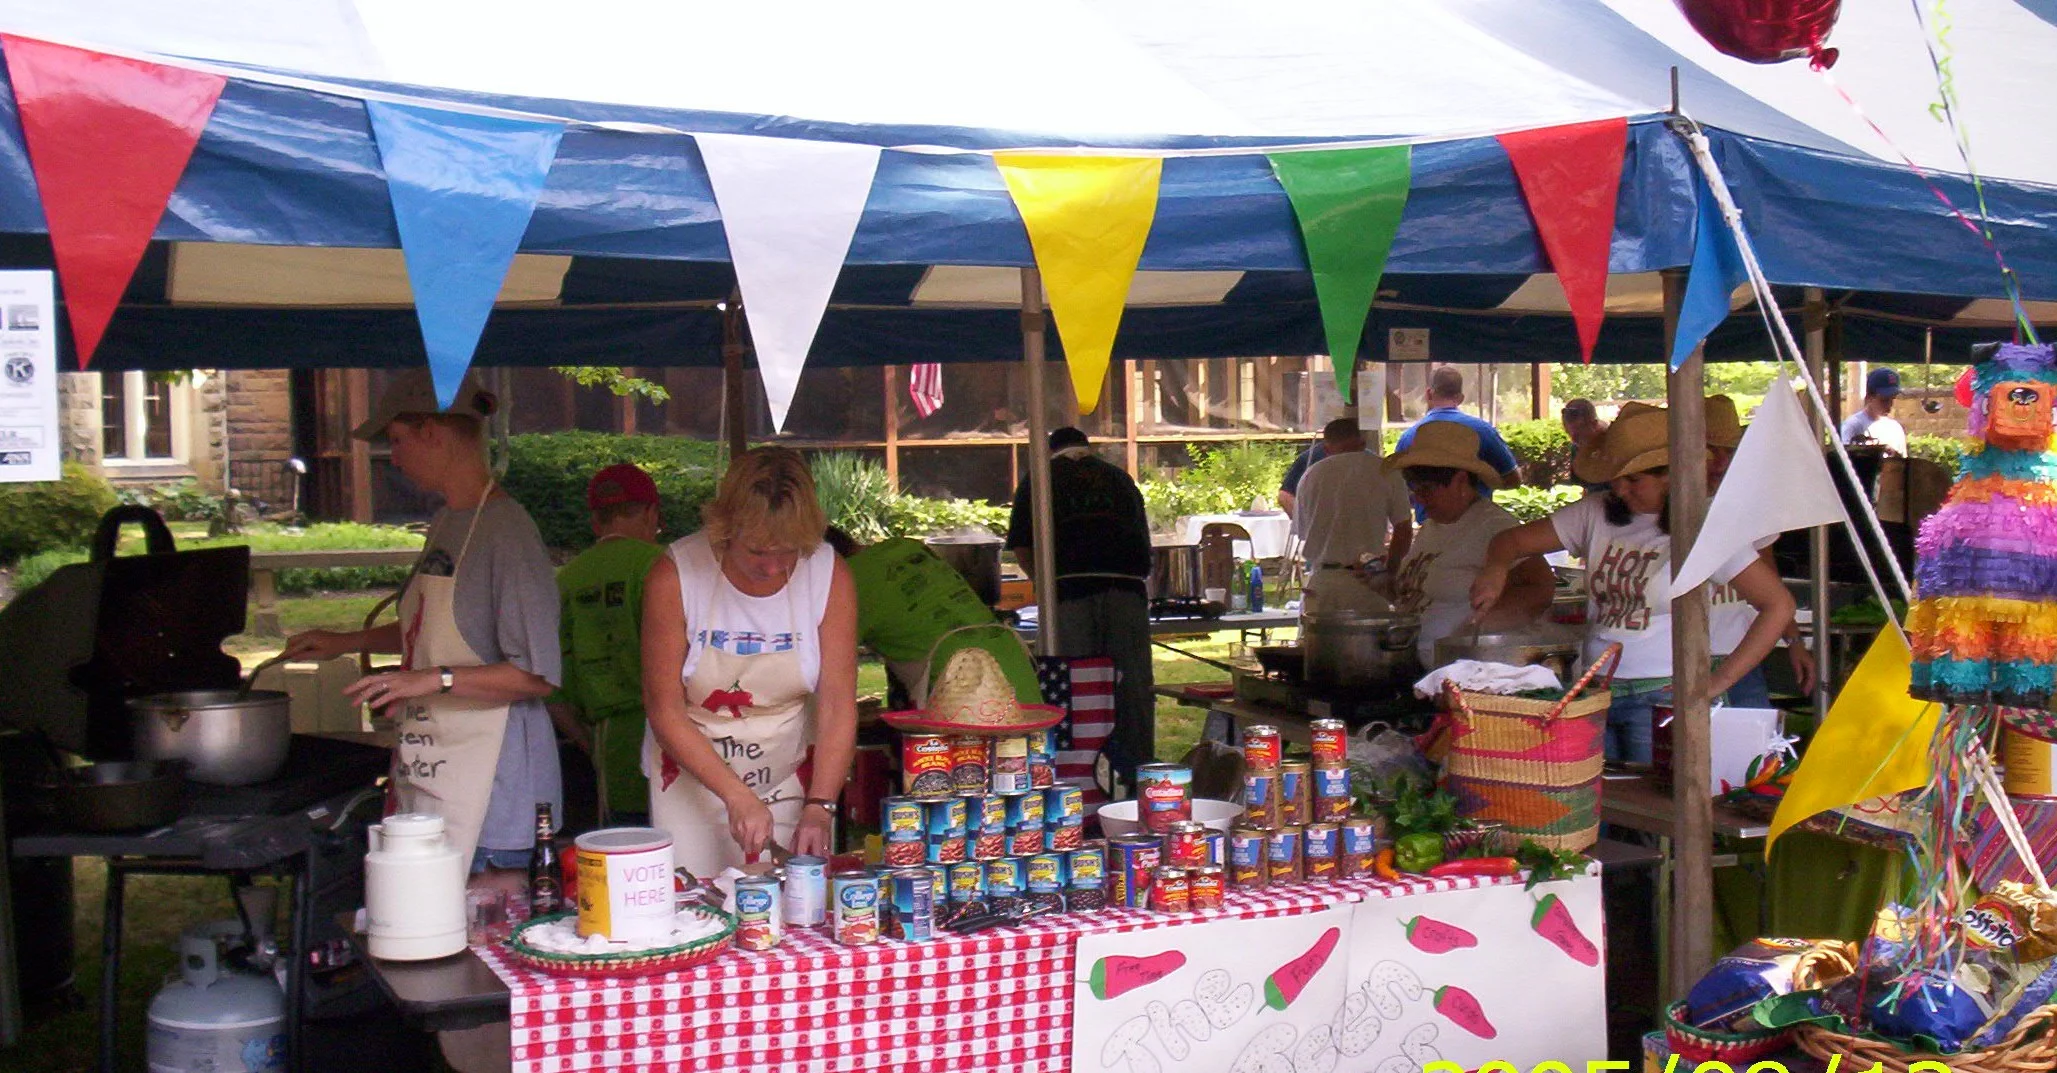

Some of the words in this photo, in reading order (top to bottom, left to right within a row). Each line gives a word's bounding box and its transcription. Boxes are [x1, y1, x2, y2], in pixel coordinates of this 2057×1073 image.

[1598, 544, 1660, 579] HOT
[712, 735, 764, 760] The
[622, 863, 666, 883] VOTE
[623, 886, 666, 907] HERE
